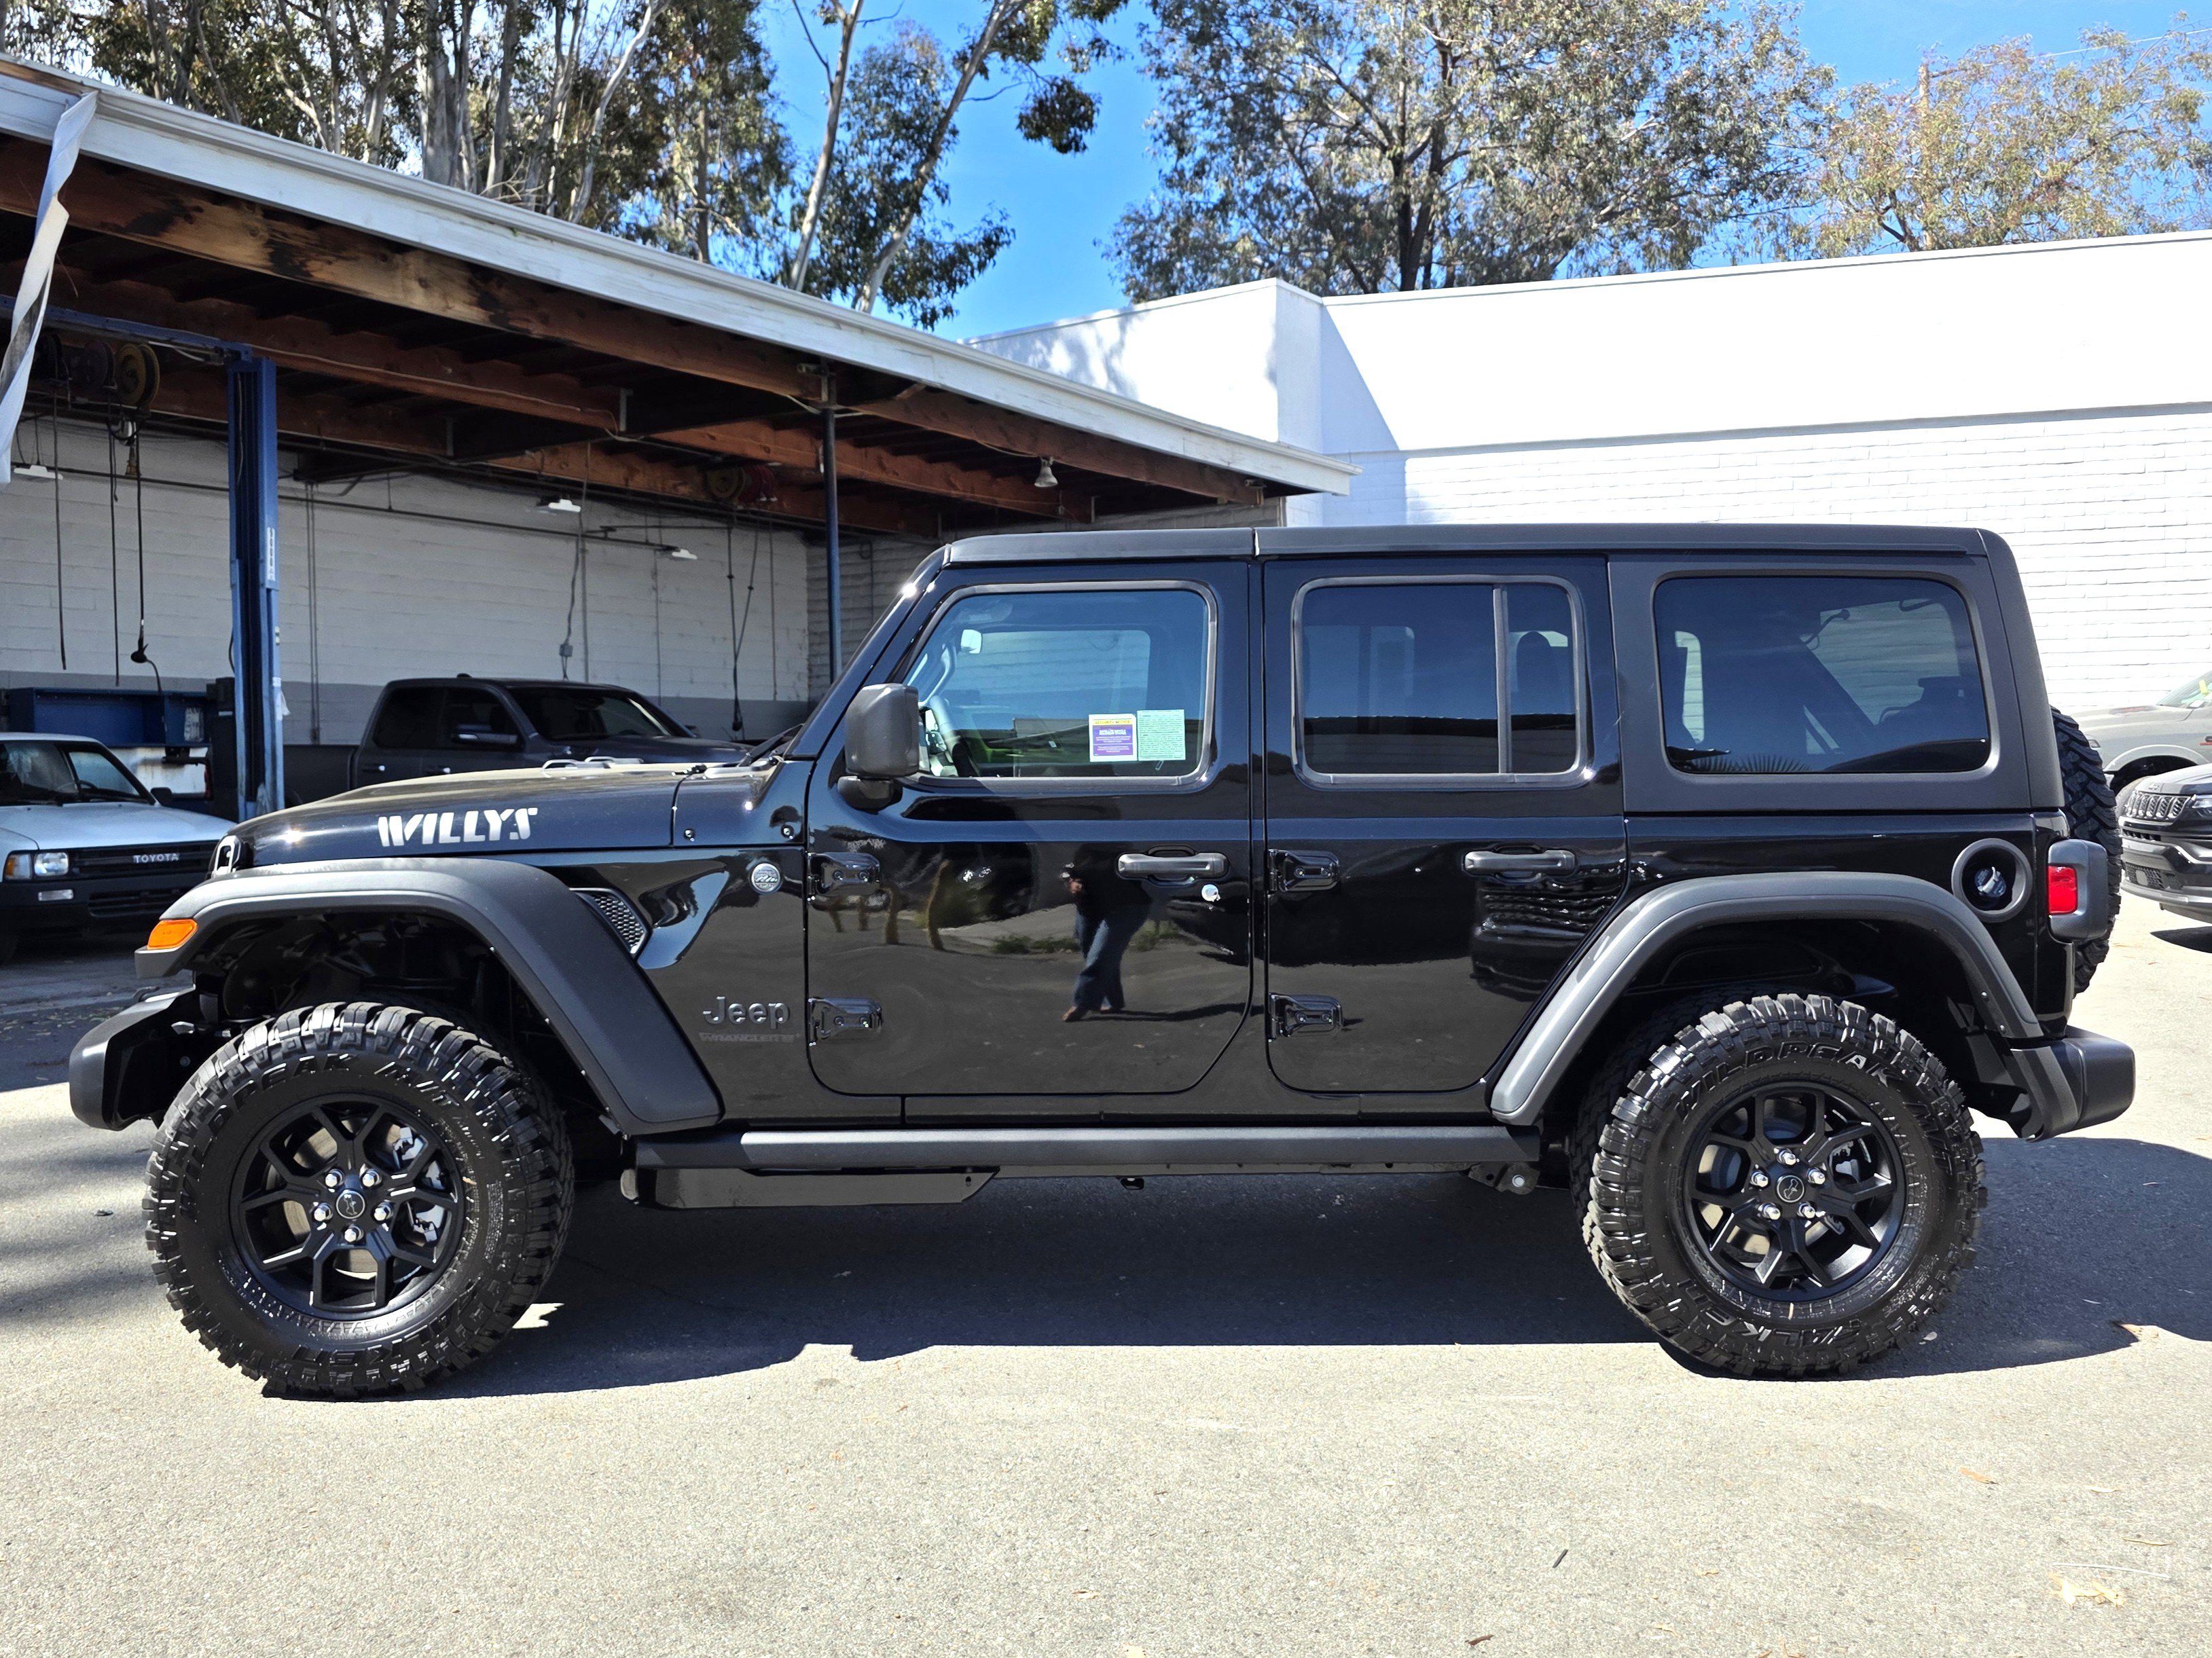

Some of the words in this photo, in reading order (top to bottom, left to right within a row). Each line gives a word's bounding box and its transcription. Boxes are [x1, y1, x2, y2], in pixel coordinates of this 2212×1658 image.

[378, 807, 538, 847] WILLYS
[133, 853, 179, 864] TOYOTA
[702, 996, 789, 1029] Jeep
[1674, 1041, 1901, 1123] WILDPEAK
